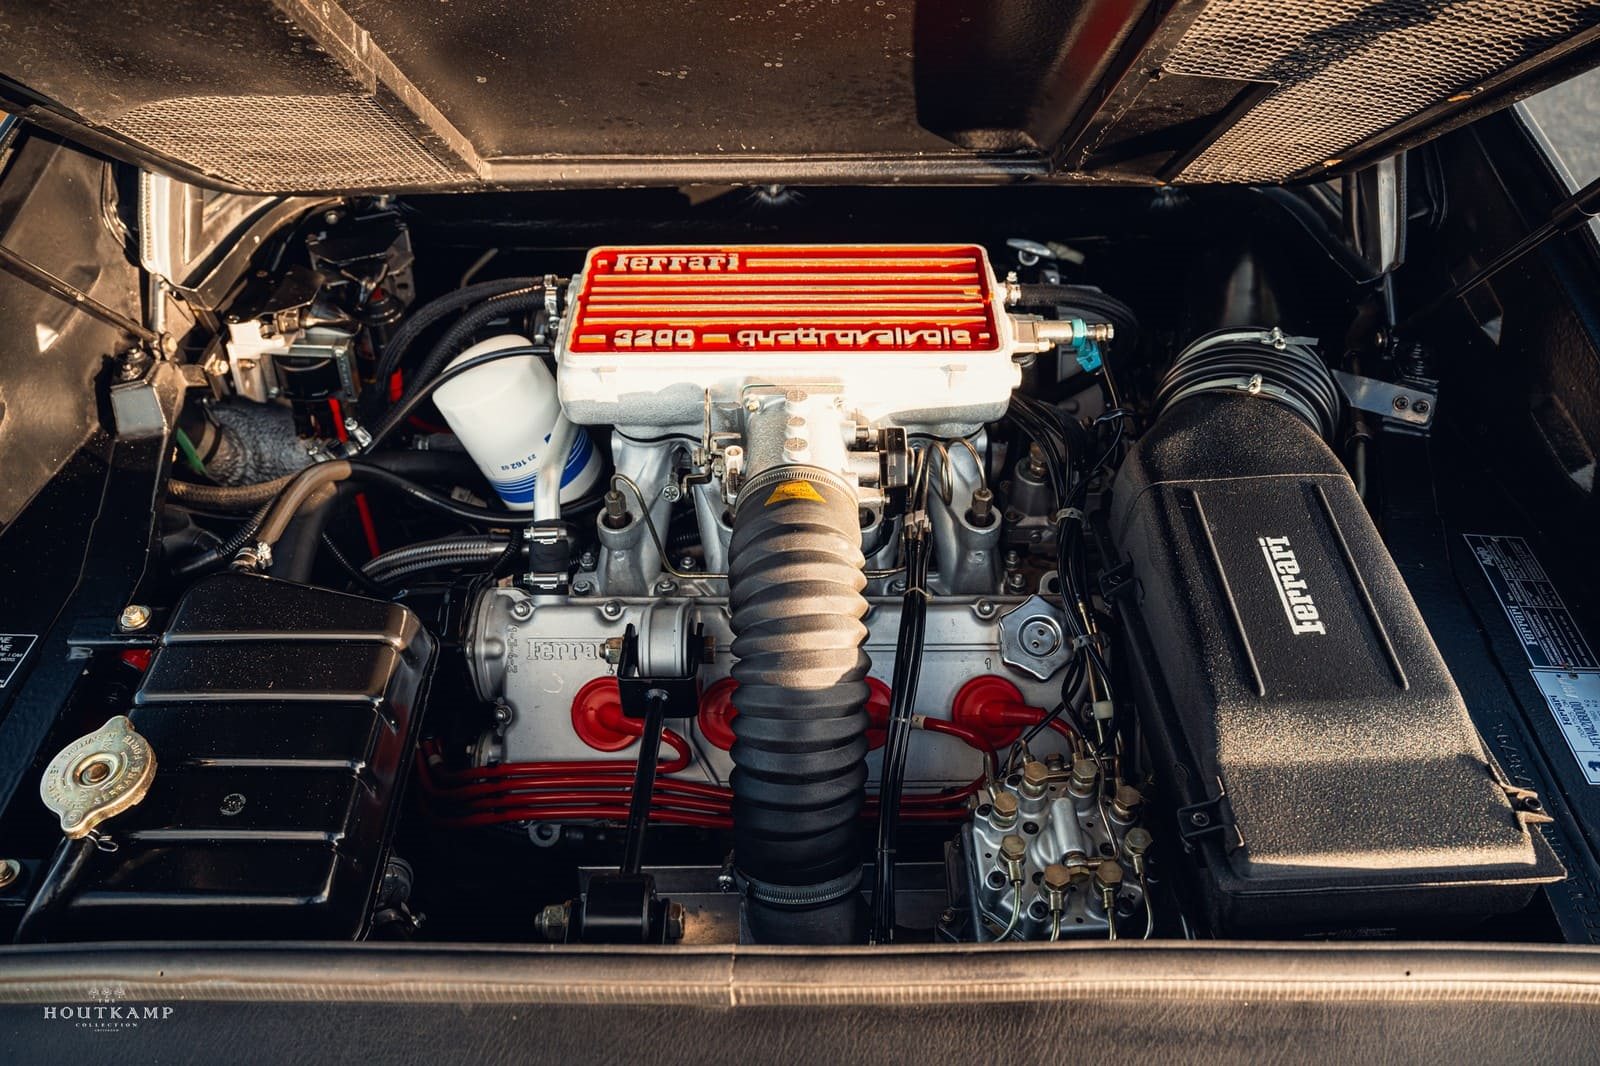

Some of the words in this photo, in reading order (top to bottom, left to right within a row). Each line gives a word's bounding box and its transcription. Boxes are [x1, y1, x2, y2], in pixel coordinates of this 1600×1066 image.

[613, 253, 739, 272] Ferrari
[613, 328, 695, 346] 3200
[511, 459, 527, 470] 162
[1257, 535, 1327, 635] Ferrari
[1506, 604, 1539, 647] Ferrari
[1548, 694, 1572, 726] Ferrari
